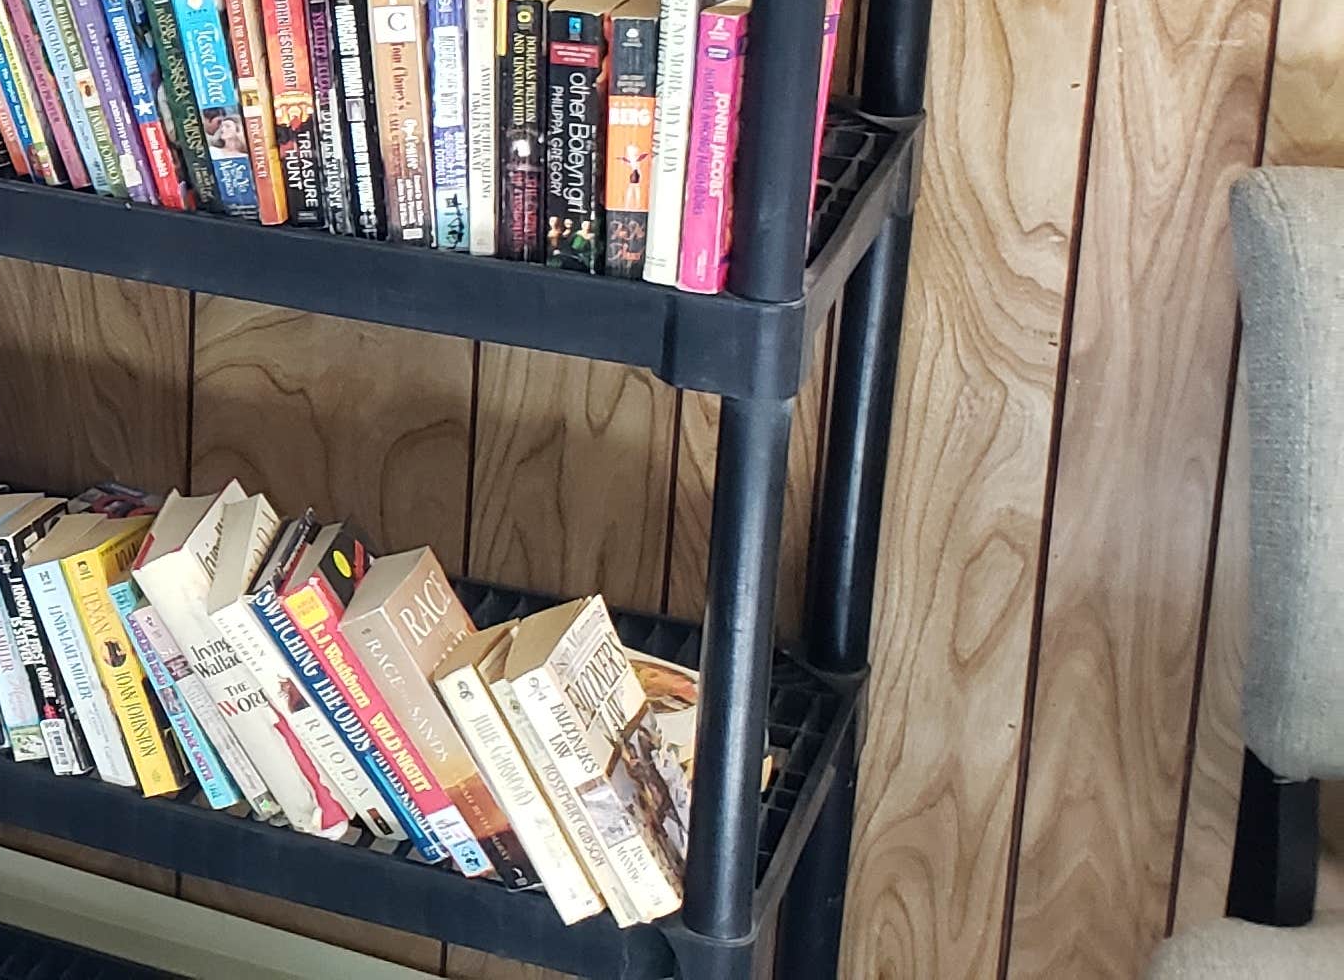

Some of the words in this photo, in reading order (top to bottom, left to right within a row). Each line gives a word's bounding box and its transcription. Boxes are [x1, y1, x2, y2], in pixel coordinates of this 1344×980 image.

[278, 26, 298, 90] LESCROART
[548, 85, 565, 139] PHILIPPA
[568, 71, 587, 120] other
[284, 149, 303, 191] HUNT
[297, 131, 318, 207] TREASURE
[546, 141, 563, 198] GREGORY
[83, 588, 112, 636] TEXAN
[192, 636, 232, 663] Irving
[255, 588, 318, 677] SWITCHING
[334, 708, 372, 752] ODDS
[323, 642, 372, 708] Washburn
[224, 682, 250, 697] THE
[122, 703, 158, 758] JOHNSTON
[304, 719, 370, 798] RHODA
[369, 712, 397, 754] WILD
[394, 747, 432, 793] NIGHT
